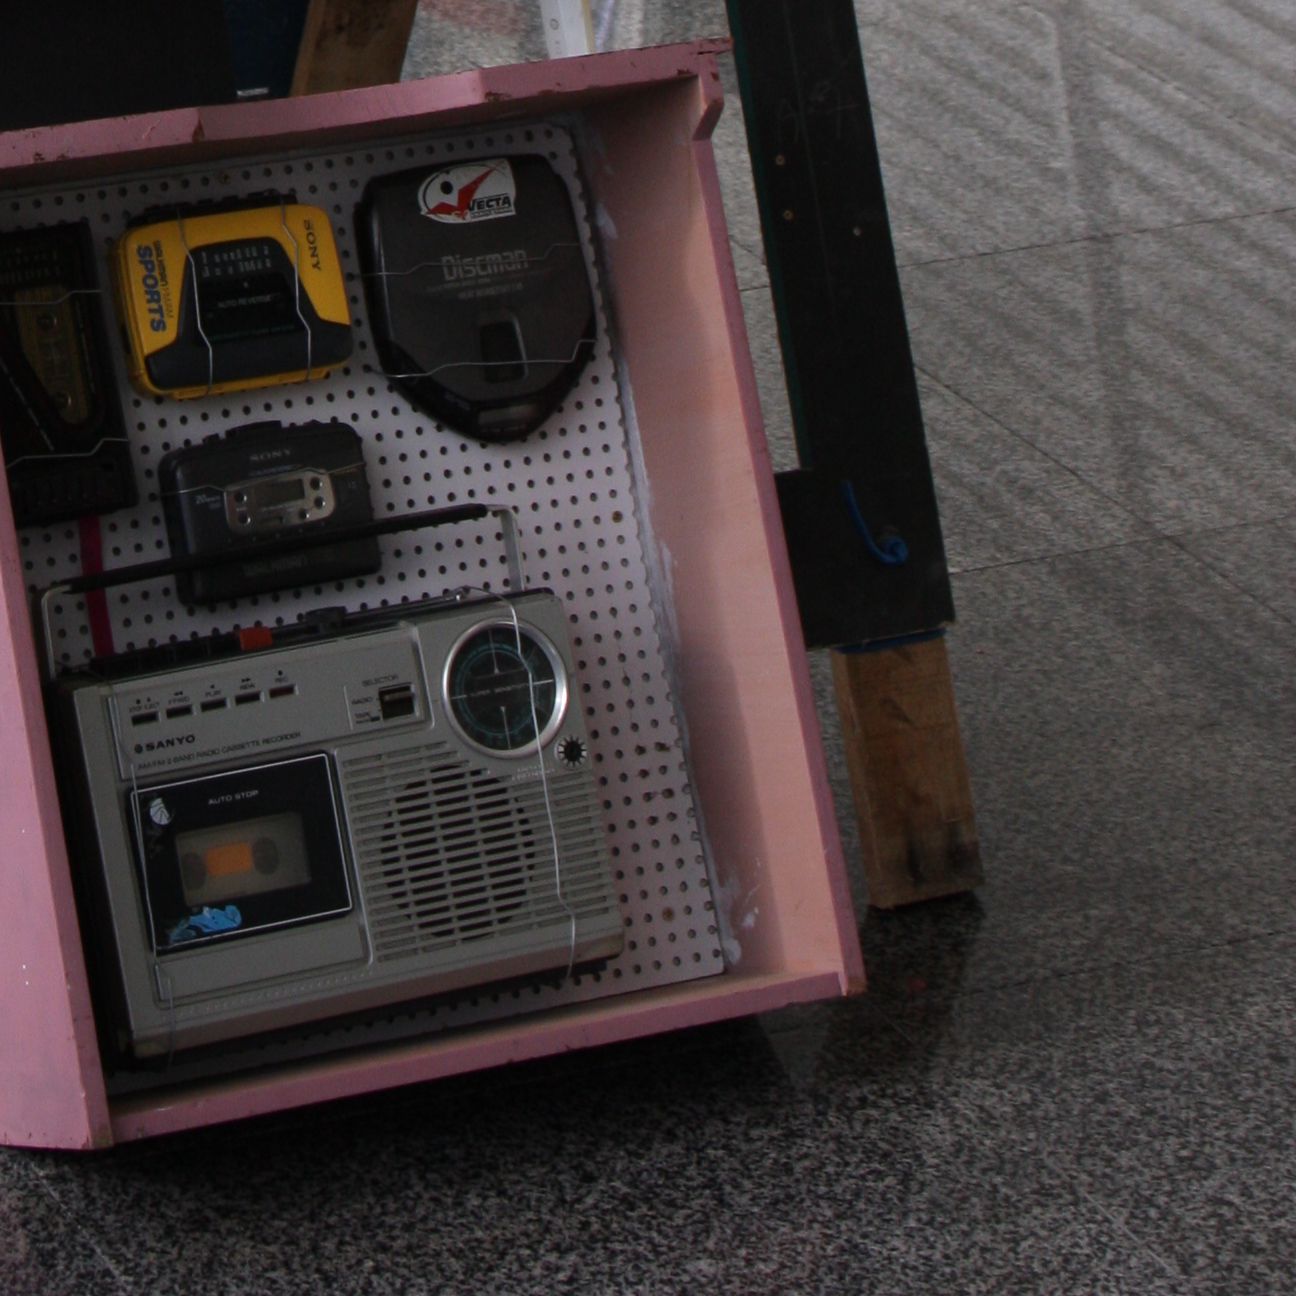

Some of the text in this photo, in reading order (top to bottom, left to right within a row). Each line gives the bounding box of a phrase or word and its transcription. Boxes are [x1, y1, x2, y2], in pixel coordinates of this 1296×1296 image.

[467, 195, 511, 212] VECTA
[303, 219, 322, 272] SONY
[441, 249, 530, 281] Discman
[137, 244, 167, 333] SPORTS
[250, 449, 292, 461] SONY
[362, 673, 399, 687] SELECTOR
[205, 689, 222, 697] PLAY
[145, 734, 196, 752] SANYO
[221, 739, 261, 755] CASSETTE
[262, 731, 301, 745] RECORDER
[208, 789, 259, 805] AUTO STOP
